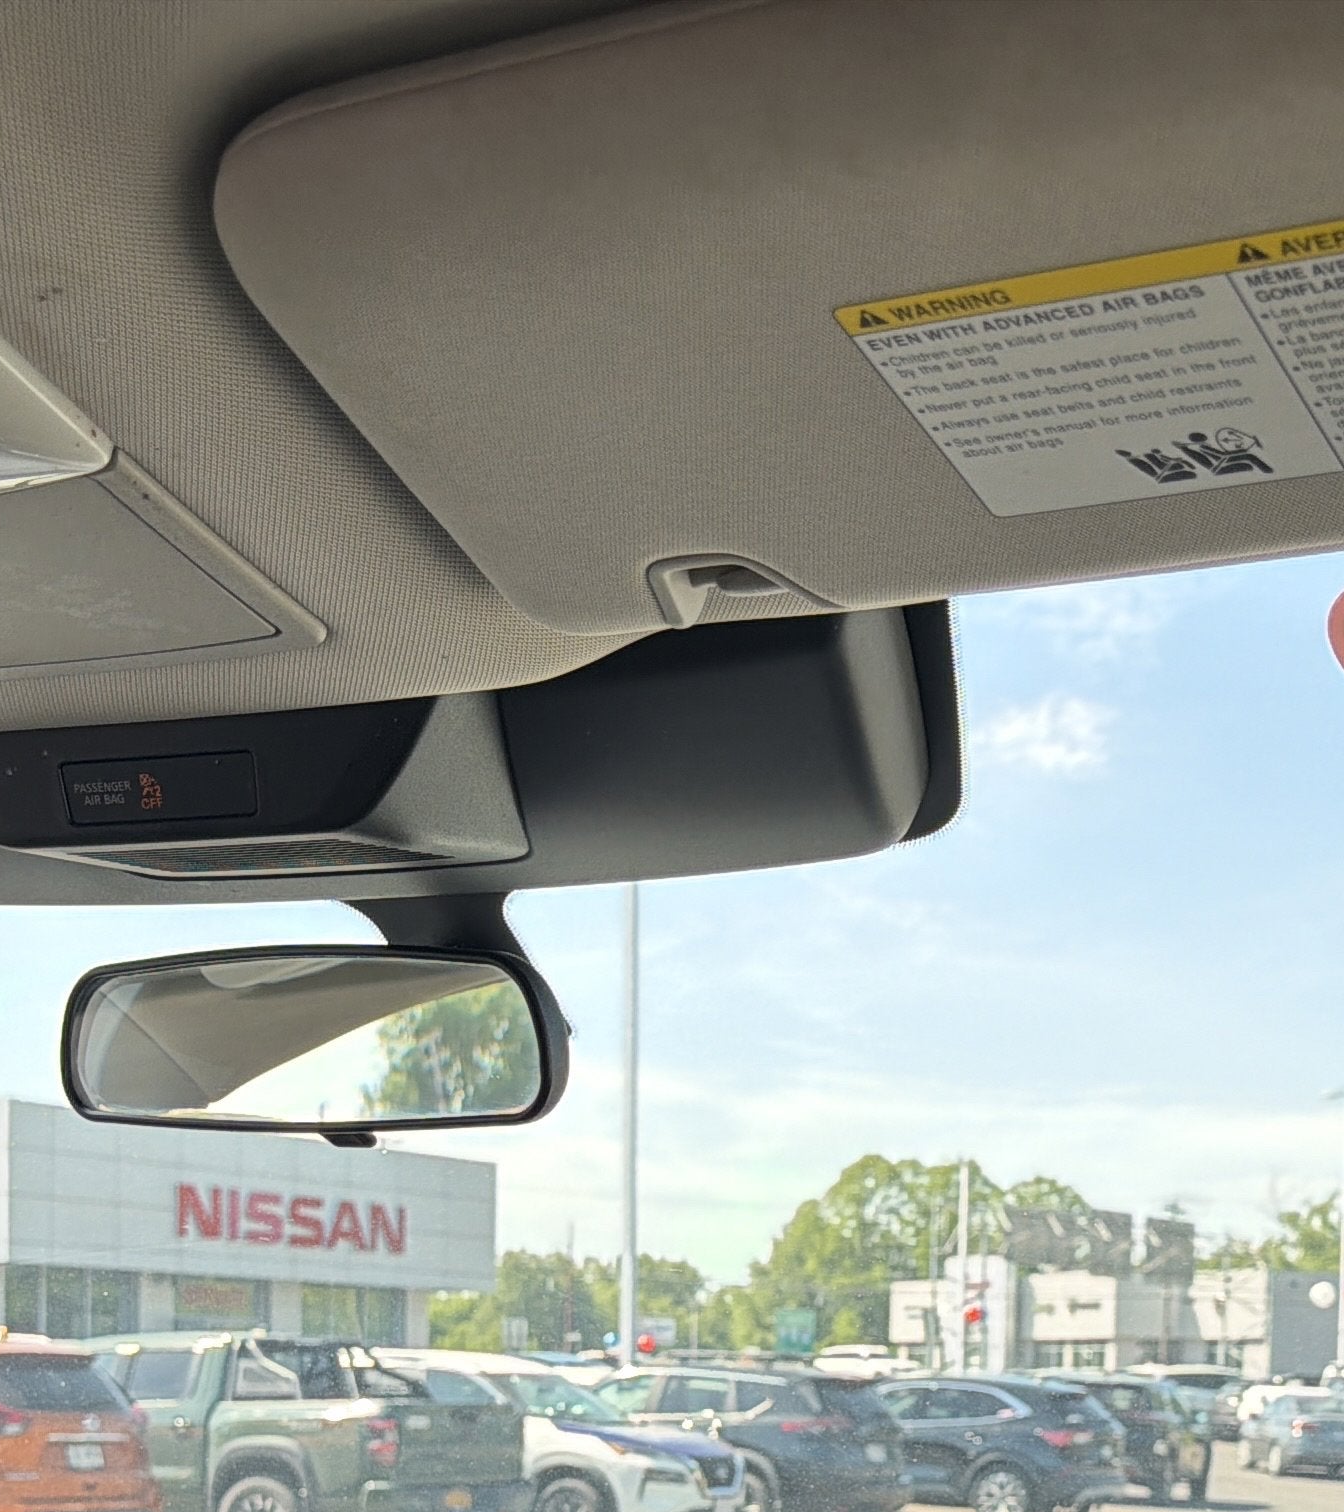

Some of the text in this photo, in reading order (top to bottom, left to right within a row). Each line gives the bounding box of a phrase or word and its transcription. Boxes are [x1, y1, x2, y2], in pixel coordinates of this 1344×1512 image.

[1243, 265, 1307, 287] MÊME
[866, 285, 1206, 351] EVEN WITH ADVANCED AIR BAGS
[888, 288, 1012, 322] WARNING
[888, 309, 1198, 366] Children can be killed or seriously injured
[897, 356, 998, 379] by the air bag
[911, 336, 1242, 395] The back seat is the safest place for children
[925, 355, 1257, 413] Never put a rear-facing child seat in the front
[939, 378, 1242, 432] Always use seat belts and child restraints
[952, 396, 1254, 447] See owner's manual for more information
[961, 436, 1065, 458] about air bags
[74, 781, 132, 793] PASSENGER
[84, 793, 125, 806] AIR BAG
[141, 798, 163, 810] OFF
[175, 1181, 408, 1256] NISSAN
